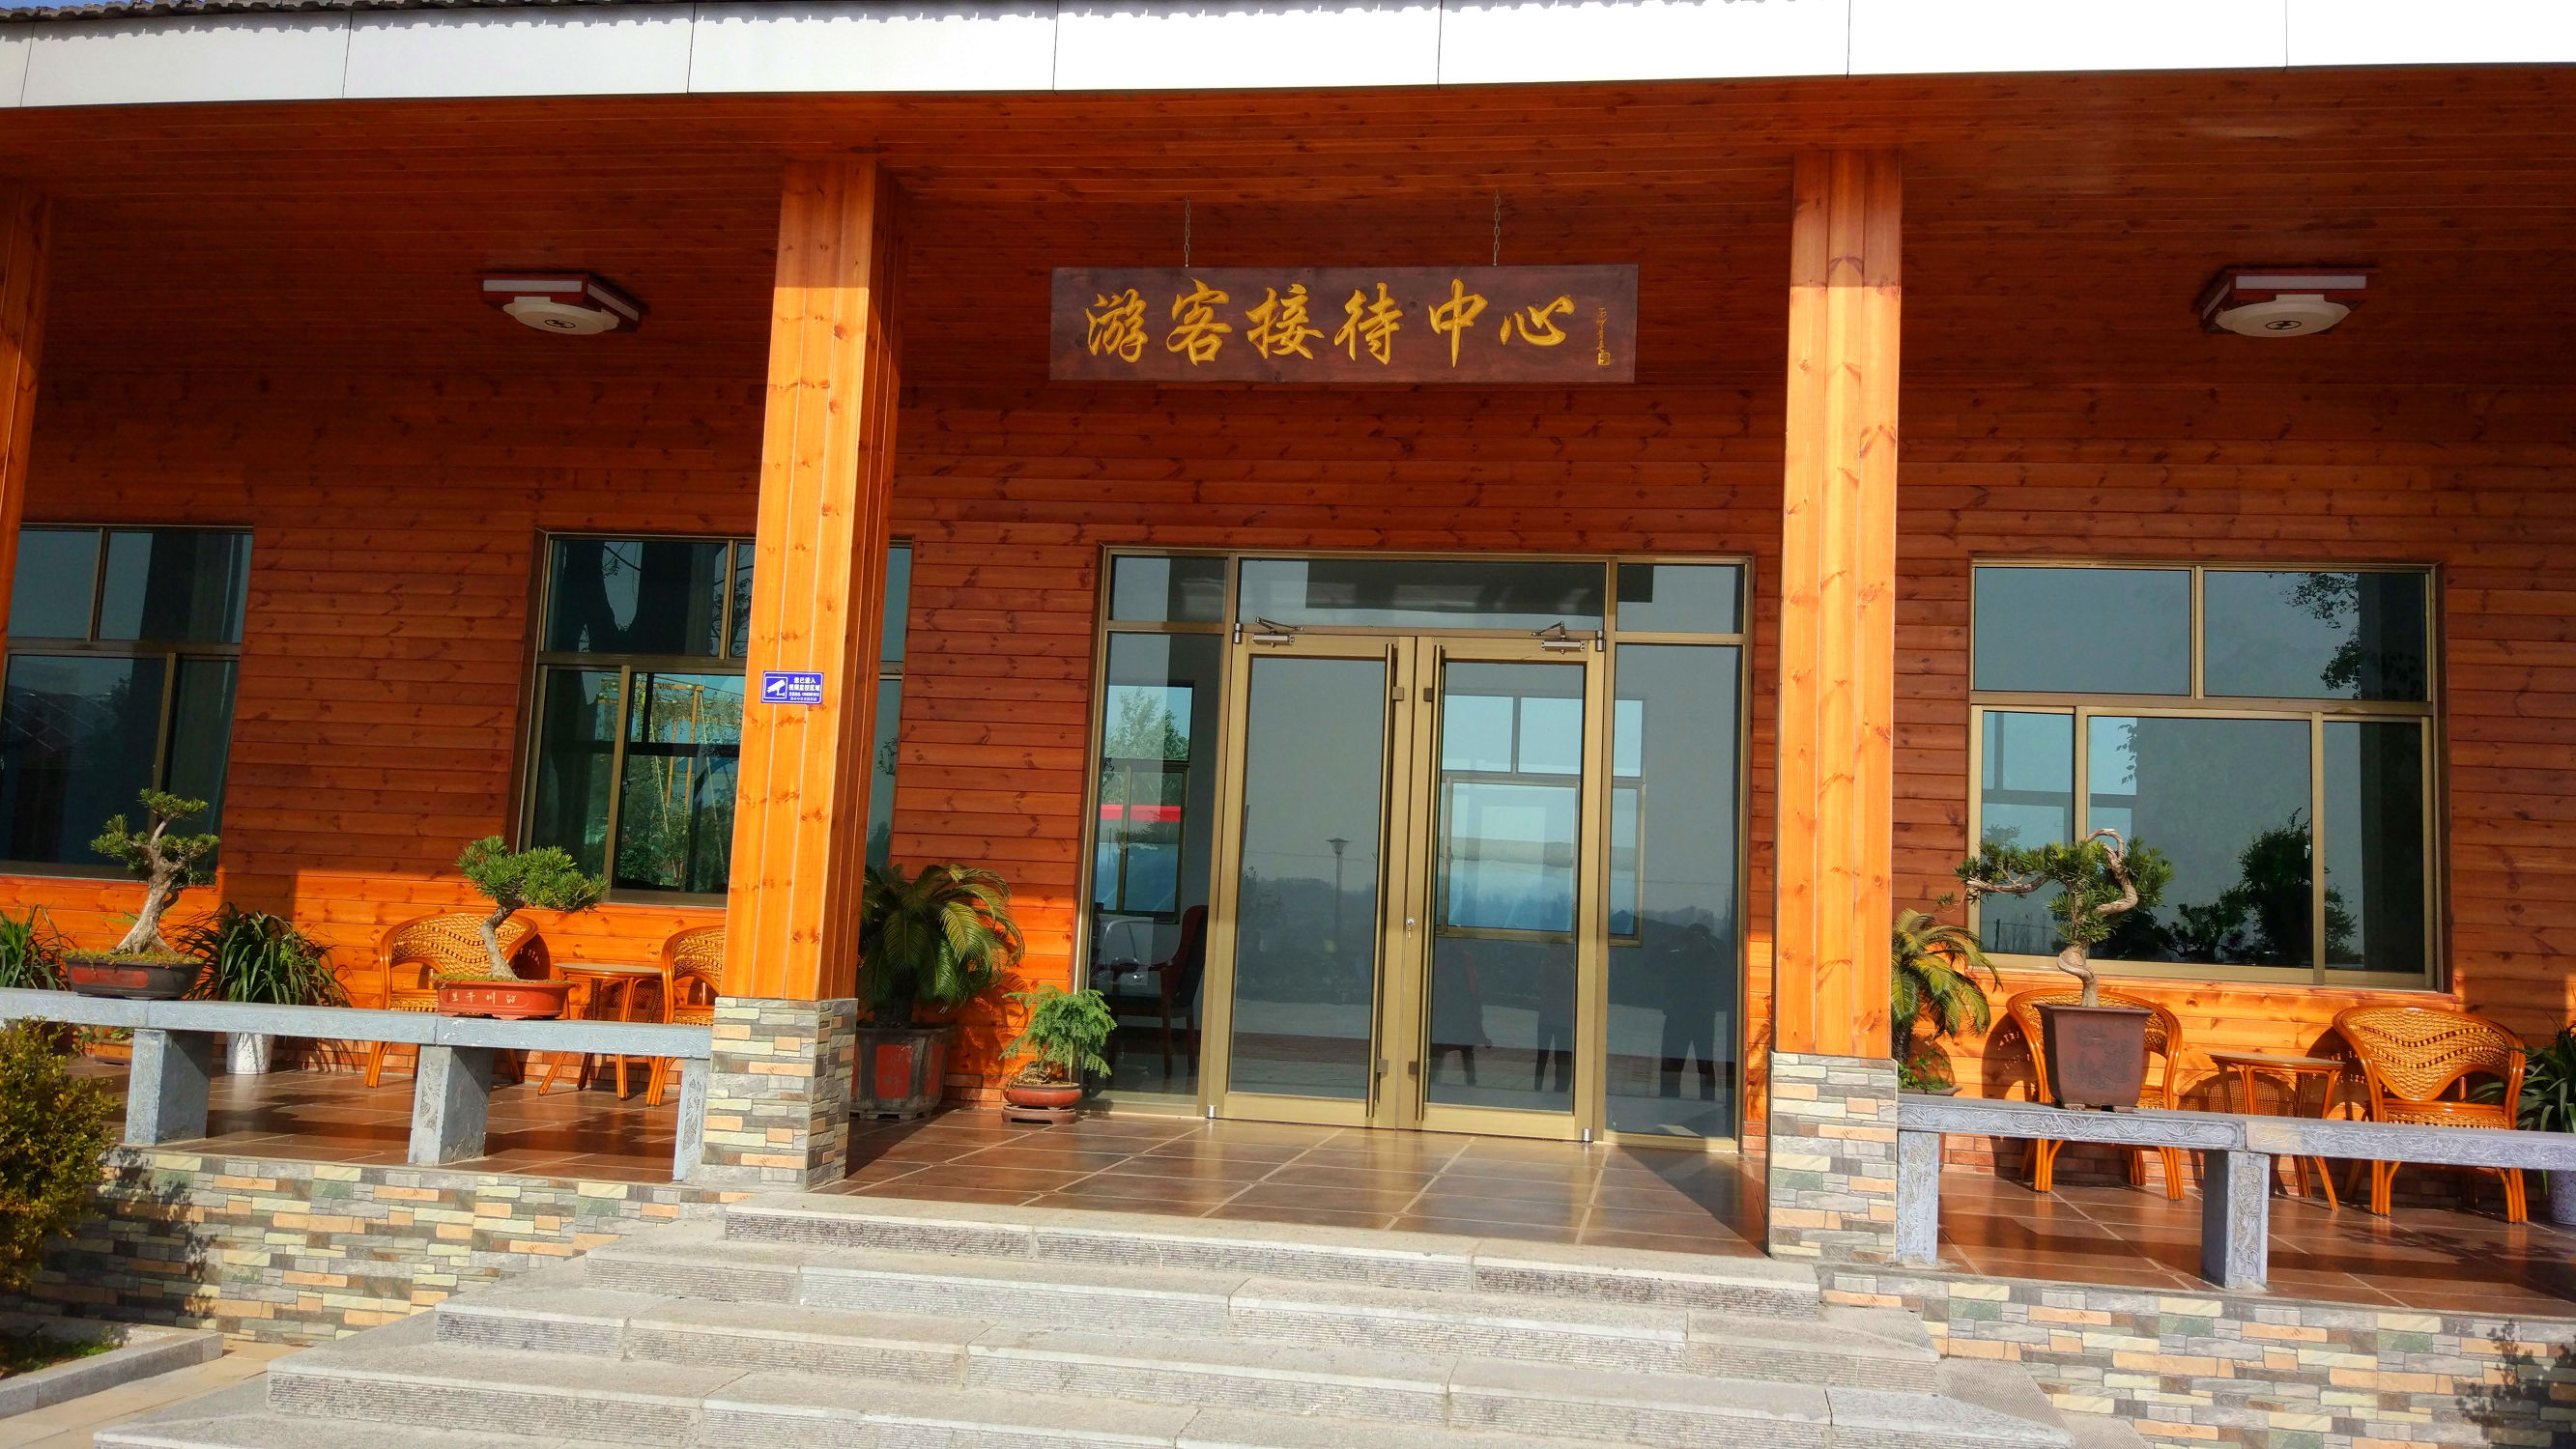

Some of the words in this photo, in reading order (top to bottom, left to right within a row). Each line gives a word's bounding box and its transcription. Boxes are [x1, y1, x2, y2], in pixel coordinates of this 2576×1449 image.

[1085, 277, 1575, 368] 游客接待中心
